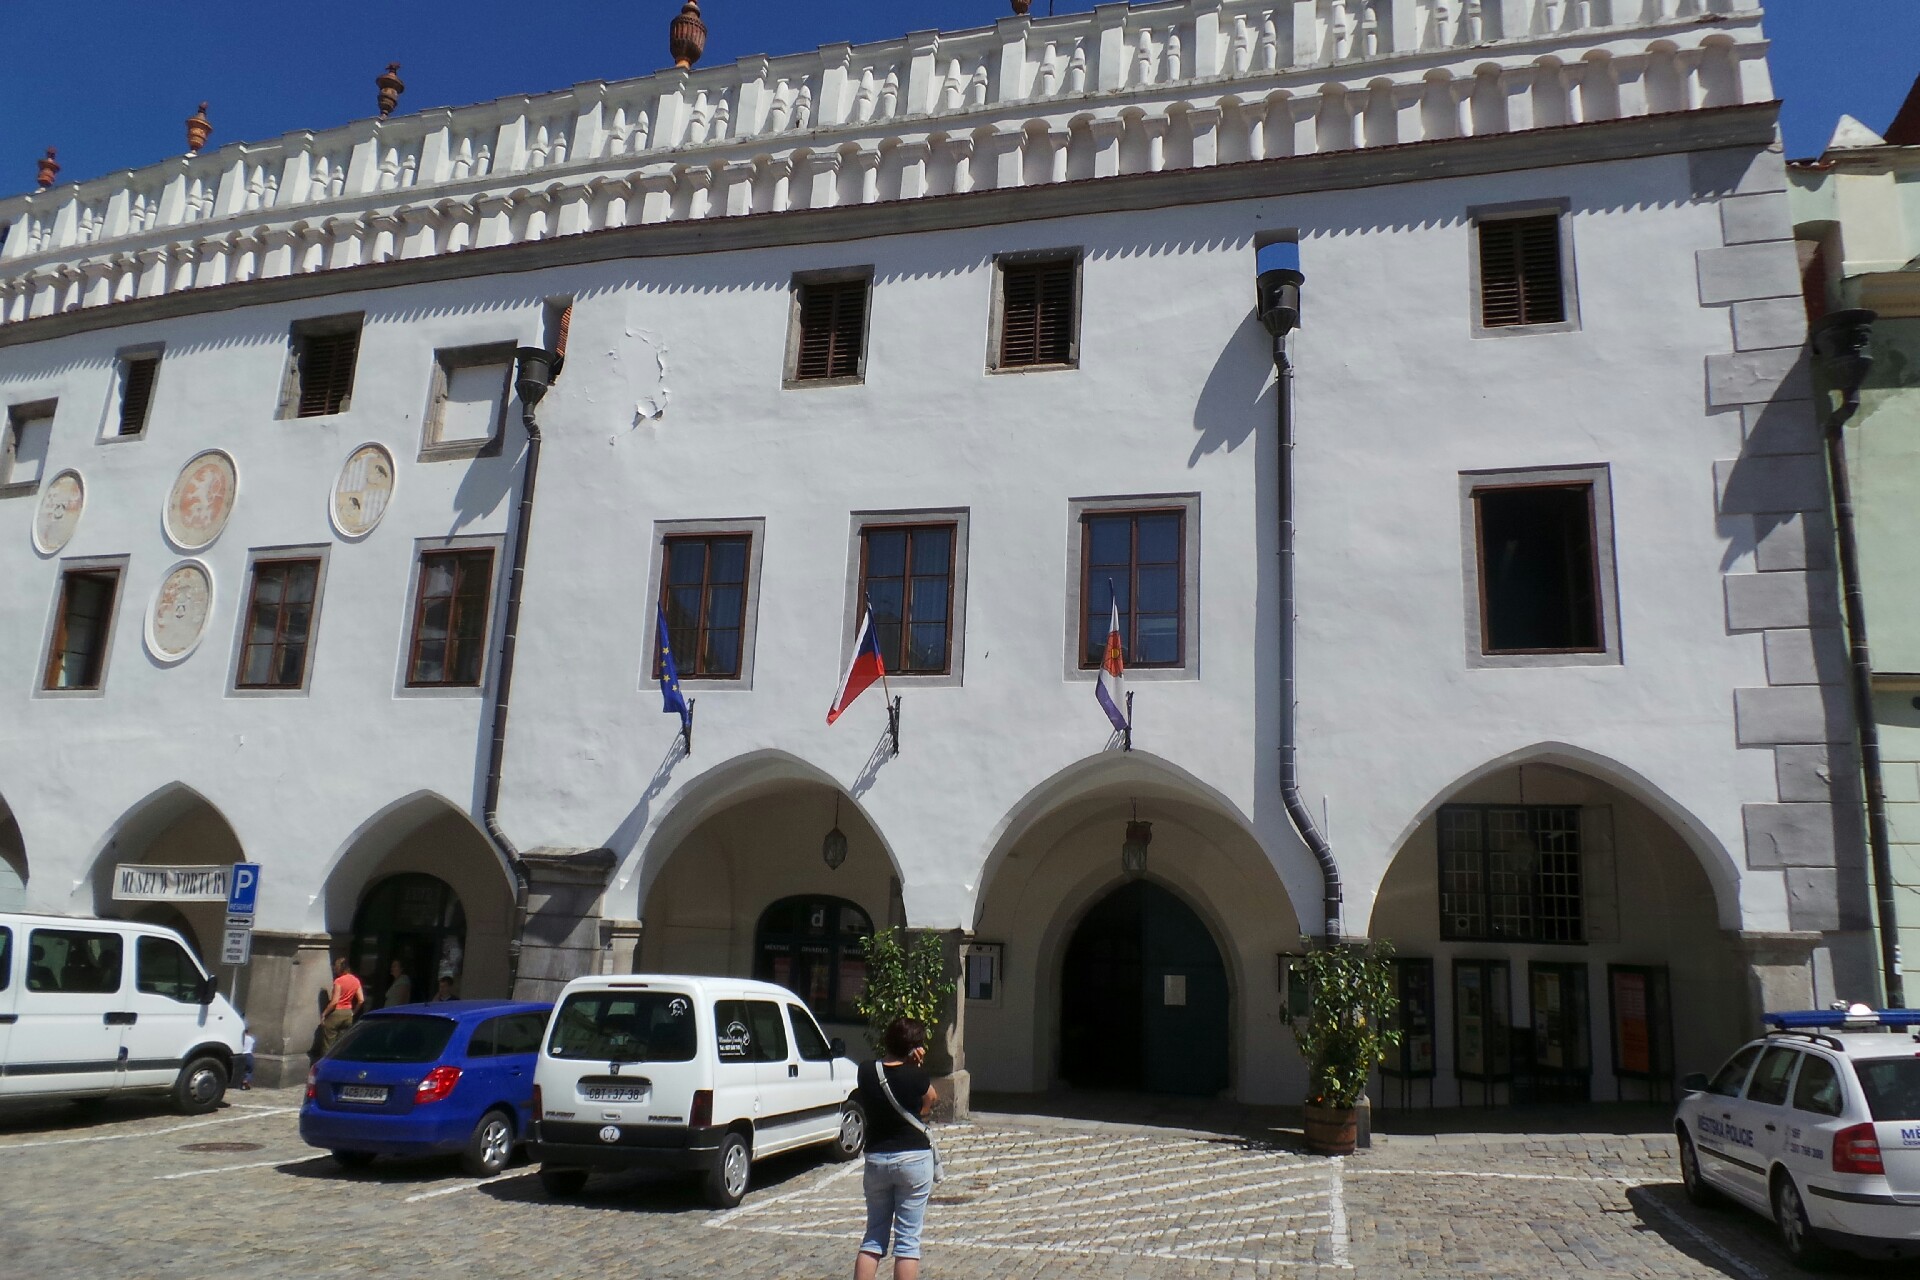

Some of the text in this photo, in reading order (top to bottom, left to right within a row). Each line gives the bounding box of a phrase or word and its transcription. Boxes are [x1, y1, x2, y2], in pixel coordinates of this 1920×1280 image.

[234, 870, 254, 898] P
[811, 909, 824, 927] d
[603, 1128, 616, 1141] CZ
